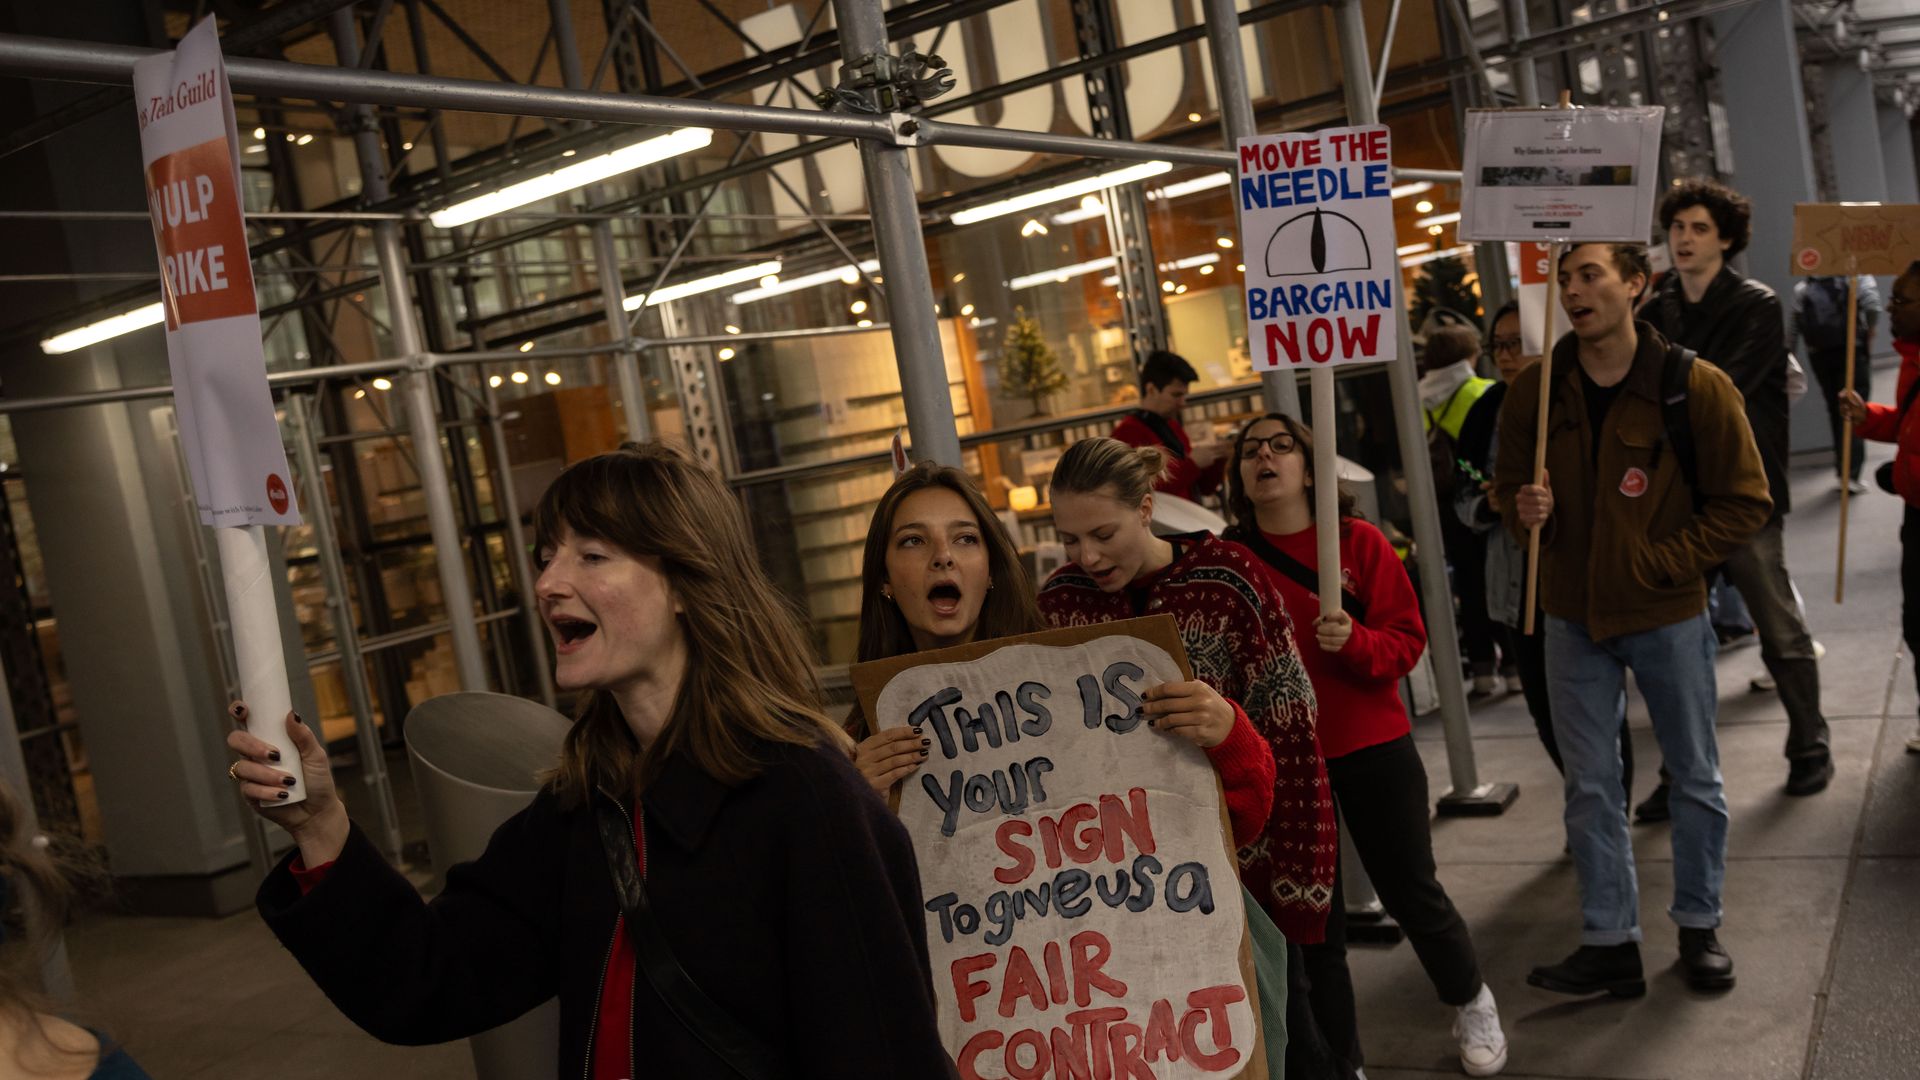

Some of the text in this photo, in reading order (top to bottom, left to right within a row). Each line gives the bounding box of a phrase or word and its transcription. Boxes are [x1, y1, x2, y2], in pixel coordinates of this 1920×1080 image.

[177, 69, 216, 110] Guild
[1240, 130, 1388, 173] MOVE THE
[1241, 164, 1391, 210] NEEDLE
[165, 245, 229, 297] RIKE
[1248, 279, 1391, 320] BARGAIN
[1265, 314, 1381, 366] NOW
[908, 661, 1145, 759] THIS IS
[994, 787, 1156, 884] SIGN
[951, 930, 1128, 1022] FAIR
[957, 984, 1246, 1080] CONTRACT
